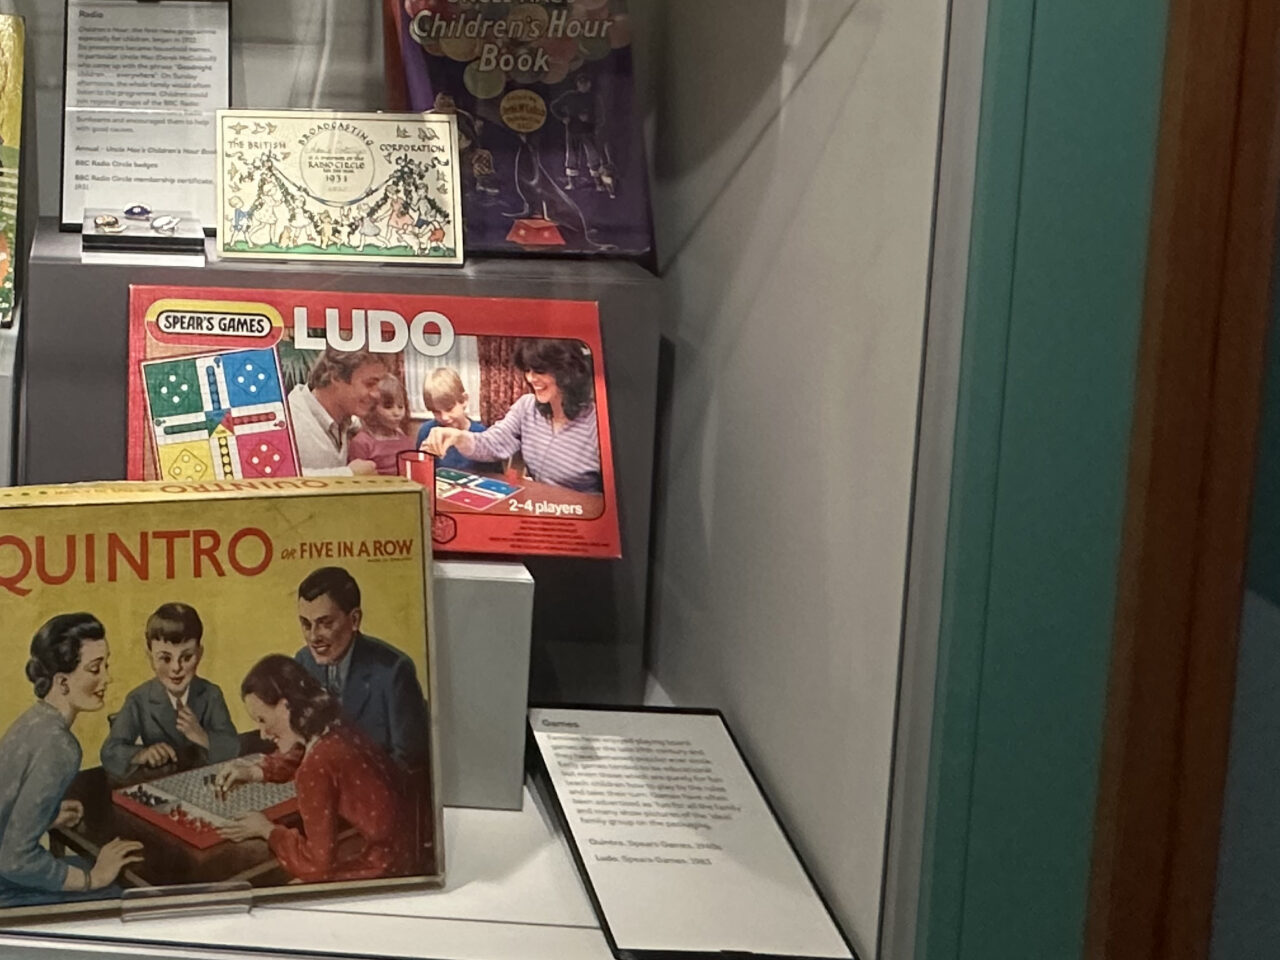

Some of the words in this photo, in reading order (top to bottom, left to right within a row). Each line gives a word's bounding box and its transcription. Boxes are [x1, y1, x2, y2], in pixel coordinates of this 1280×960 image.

[79, 10, 104, 18] Radio
[411, 9, 542, 40] Children's
[548, 8, 614, 38] Hour
[478, 43, 551, 73] Book
[247, 140, 286, 150] BRITISH
[298, 122, 375, 146] BROADCASTING
[379, 143, 445, 154] CORPORATION
[75, 160, 90, 168] BBC
[92, 160, 110, 168] Radio
[112, 160, 133, 168] Circle
[134, 162, 158, 170] badges
[308, 161, 334, 169] RADIO
[334, 162, 366, 170] CIRCLE
[75, 174, 90, 182] BBC
[91, 174, 110, 182] Radio
[134, 176, 175, 185] membership
[163, 313, 215, 332] SPEAR'S
[218, 315, 266, 334] GAMES
[293, 307, 456, 356] LUDO
[160, 478, 329, 494] QUINTRO
[508, 499, 533, 512] 2-4
[535, 500, 584, 516] players
[281, 548, 297, 560] OR
[300, 541, 334, 559] FIVE
[337, 540, 354, 558] IN
[356, 540, 371, 557] A
[373, 539, 414, 557] ROW
[542, 718, 579, 728] Games
